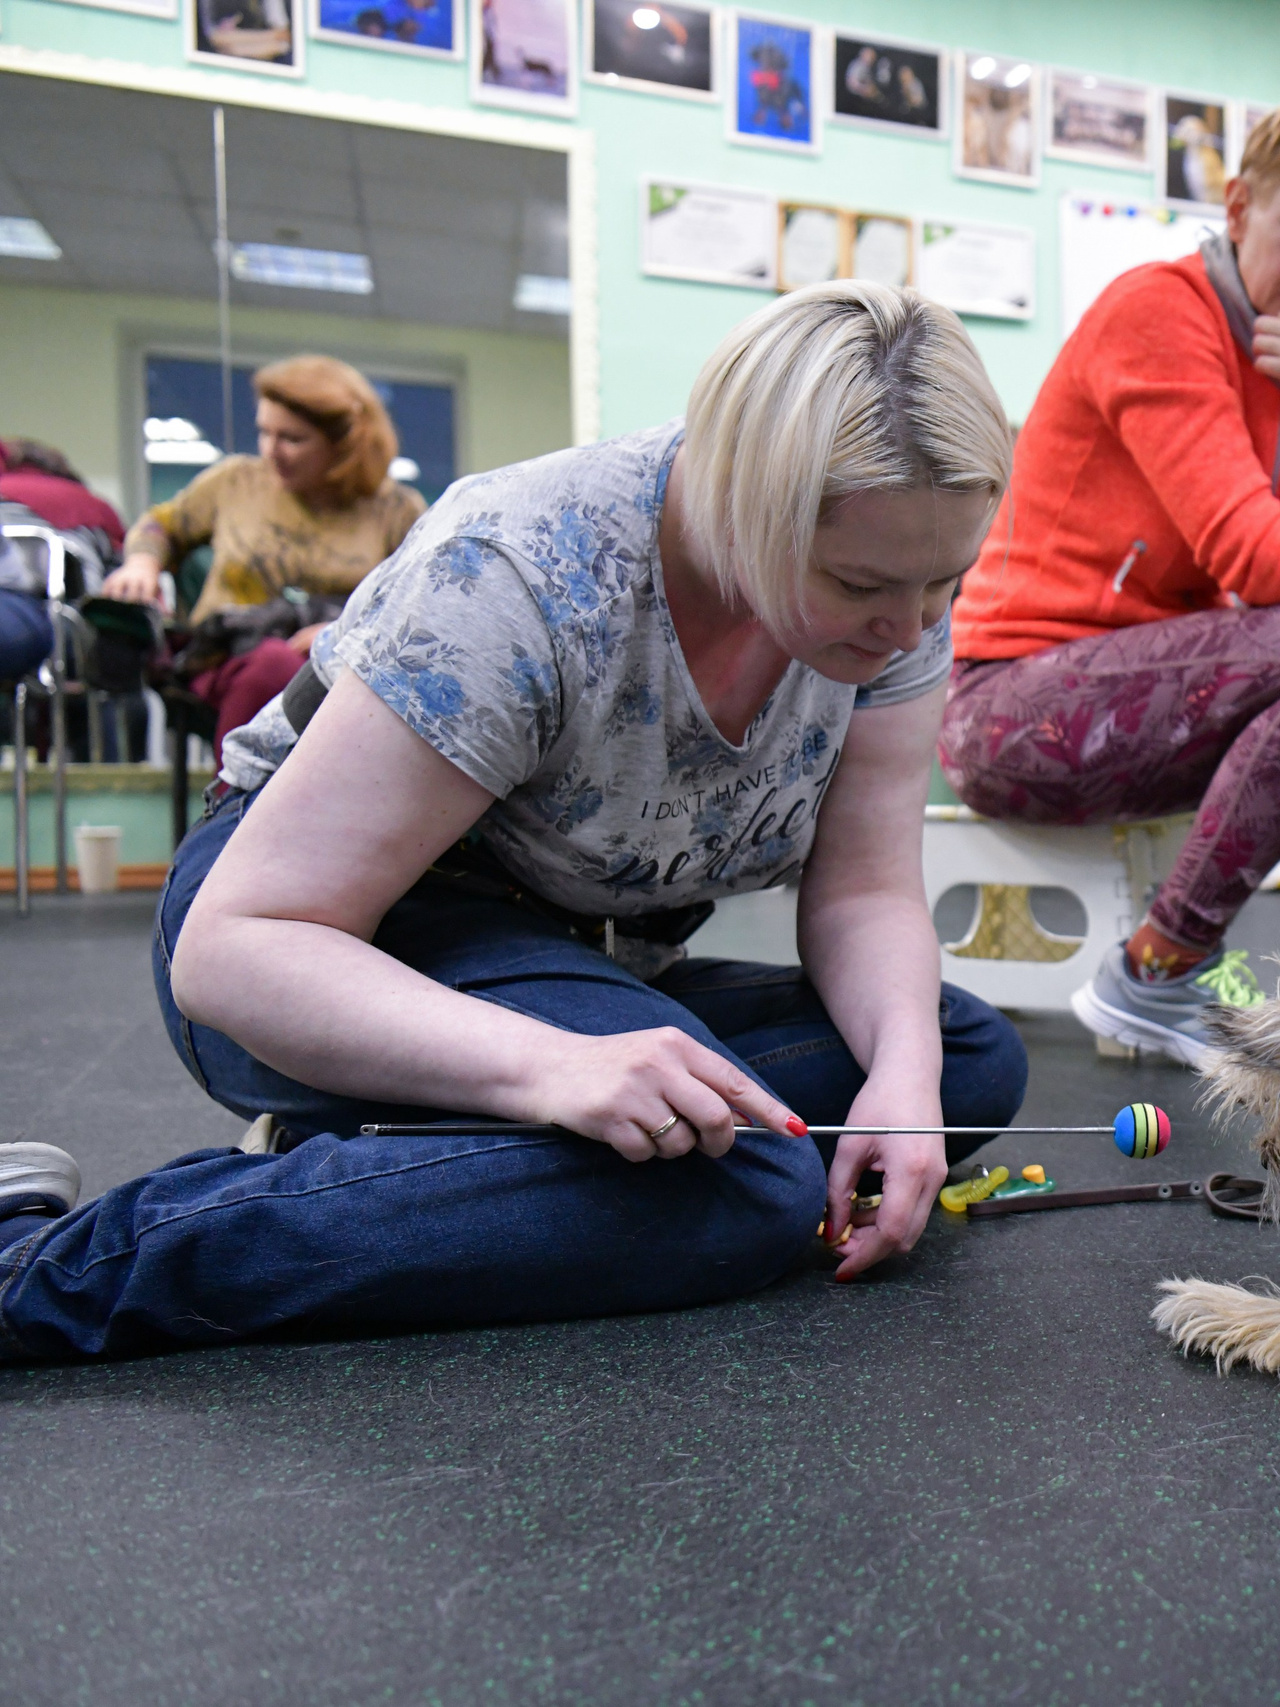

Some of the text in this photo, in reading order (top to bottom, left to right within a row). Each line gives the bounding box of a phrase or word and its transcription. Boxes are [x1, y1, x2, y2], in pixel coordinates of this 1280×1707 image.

[641, 800, 649, 819] I
[655, 789, 706, 820] DON'T
[715, 764, 776, 803] HAVE
[803, 731, 829, 757] BE
